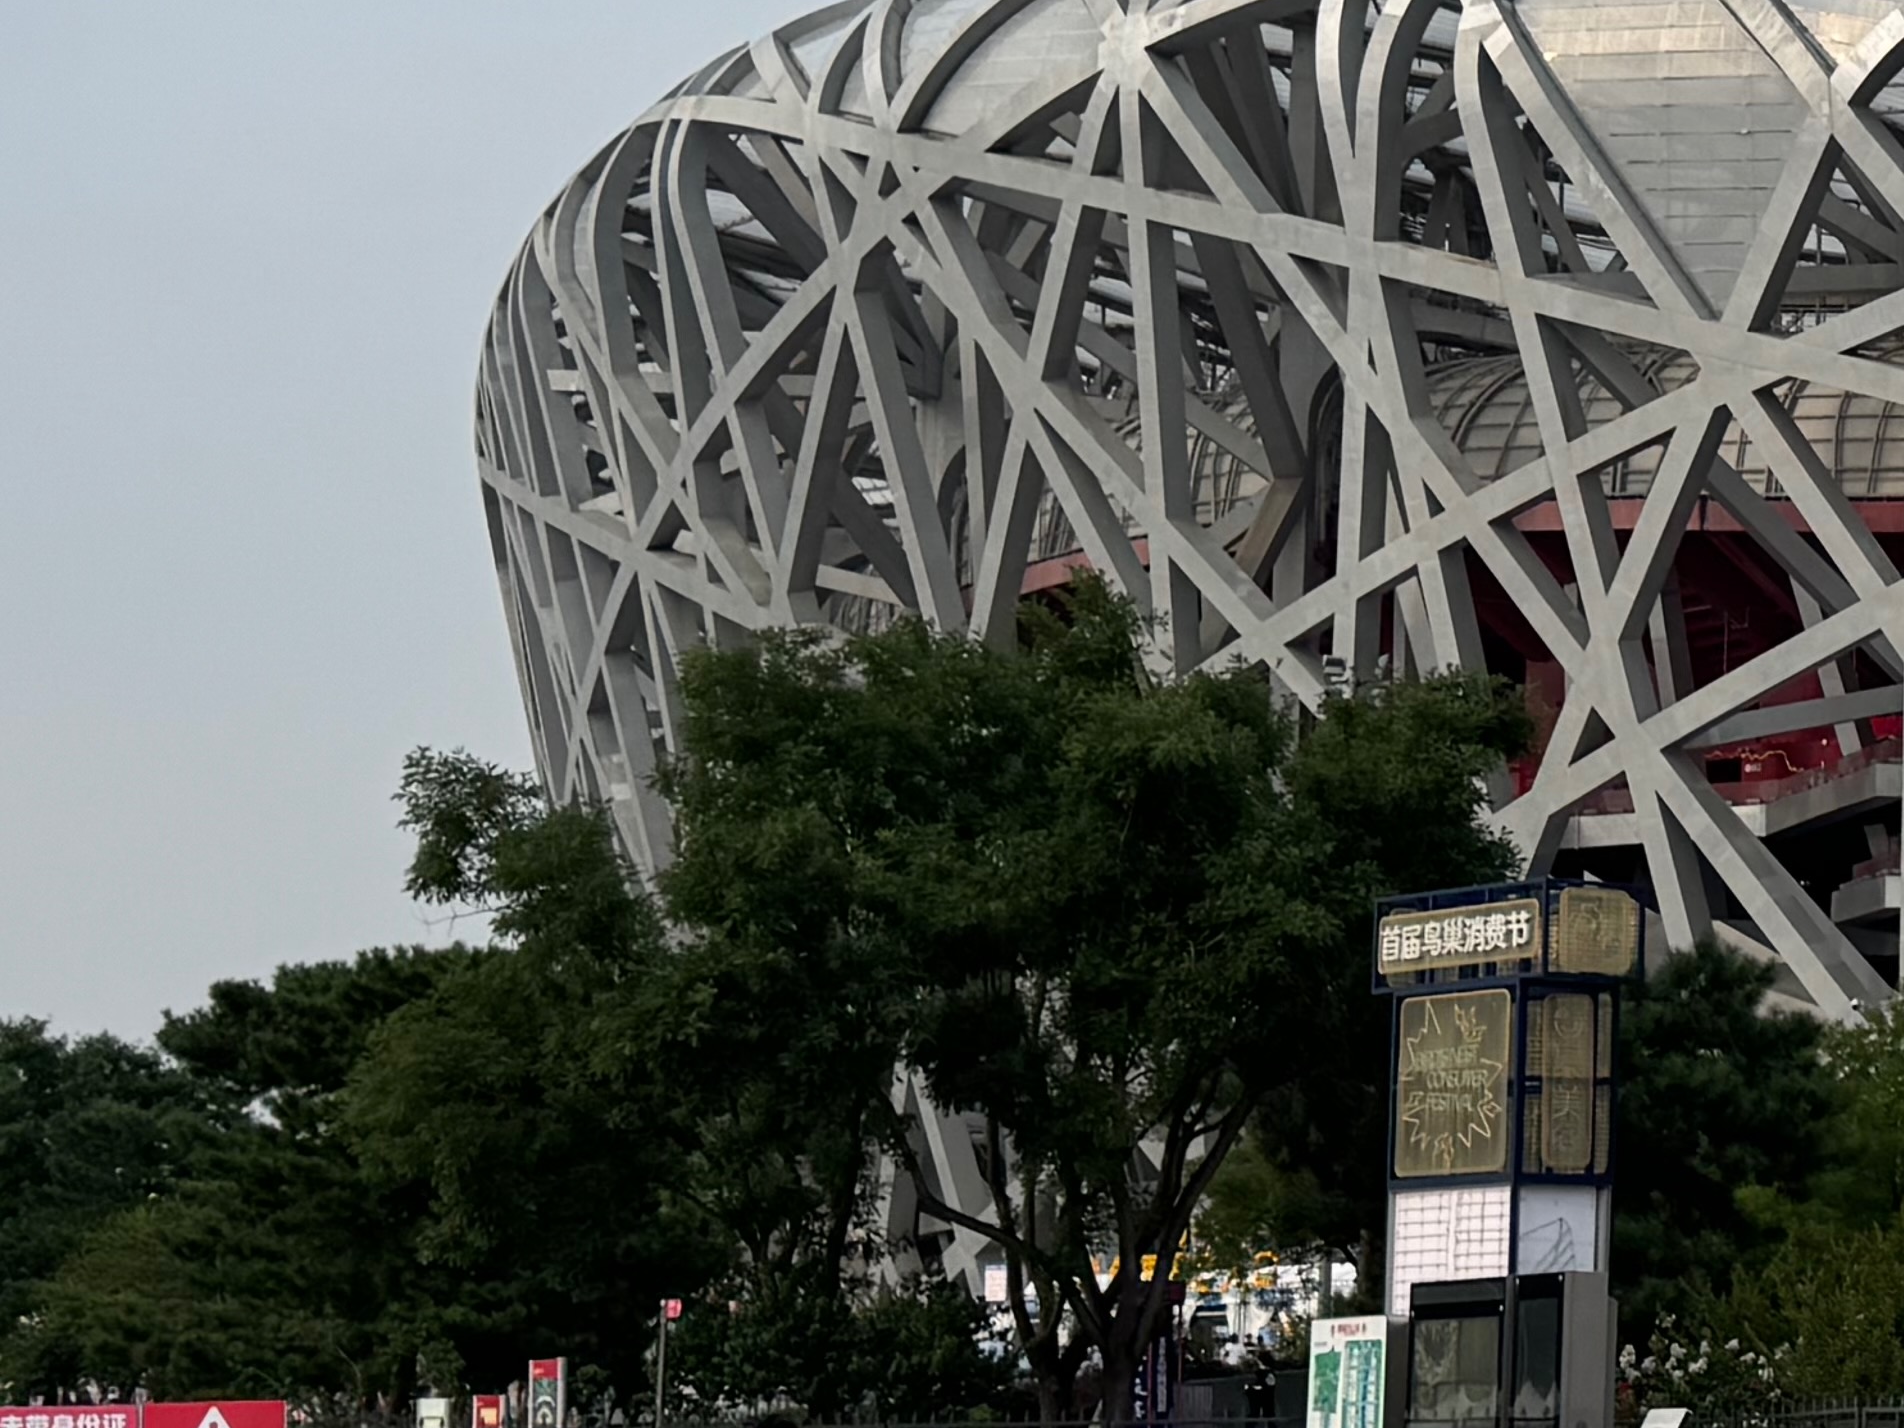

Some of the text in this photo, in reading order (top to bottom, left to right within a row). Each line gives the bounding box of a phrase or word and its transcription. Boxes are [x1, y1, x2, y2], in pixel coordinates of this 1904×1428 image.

[1381, 910, 1531, 961] 首届鸟巢消费节
